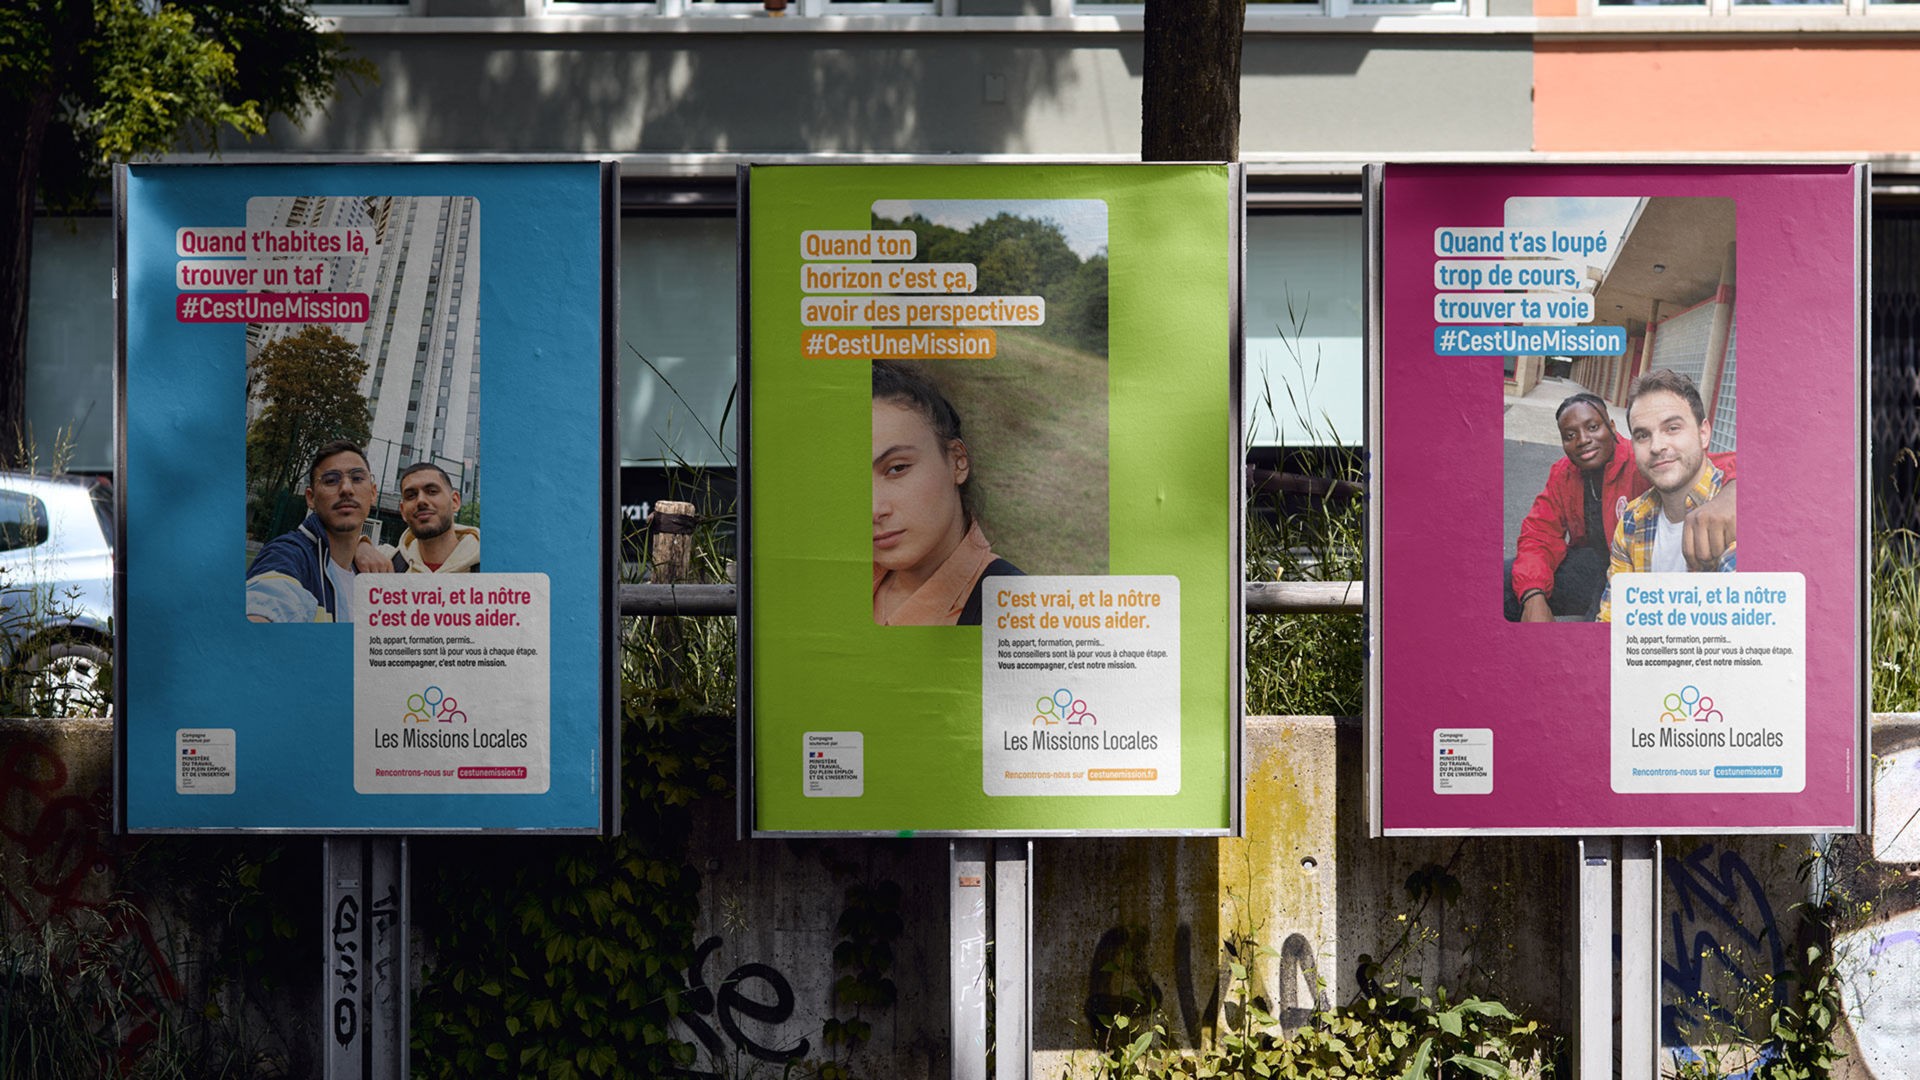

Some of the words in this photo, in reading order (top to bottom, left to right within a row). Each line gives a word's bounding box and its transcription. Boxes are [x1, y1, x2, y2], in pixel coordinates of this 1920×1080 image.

[183, 230, 246, 253] Quand
[251, 230, 341, 252] t'habites
[347, 230, 368, 255] là,
[807, 234, 871, 256] Quand
[877, 236, 911, 255] ton
[1440, 231, 1504, 254] Quand
[1510, 232, 1546, 252] t'as
[1552, 231, 1606, 257] loupé
[182, 266, 258, 285] trouver
[264, 269, 288, 286] un
[294, 263, 324, 285] taf
[806, 267, 882, 288] horizon
[888, 268, 937, 288] c'est
[944, 272, 972, 293] ça,
[1440, 265, 1482, 290] trop
[1488, 264, 1513, 286] de
[1518, 269, 1581, 288] cours,
[182, 296, 362, 318] #CestUneMission
[806, 300, 858, 321] avoir
[864, 300, 900, 321] des
[906, 300, 1040, 326] perspectives
[1440, 298, 1516, 318] trouver
[1520, 299, 1540, 318] ta
[1547, 296, 1588, 318] voie
[807, 332, 990, 354] #CestUneMission
[1440, 329, 1620, 351] #CestUneMission
[369, 588, 408, 604] C'est
[412, 587, 445, 607] vrai,
[450, 589, 466, 604] et
[470, 588, 483, 604] la
[488, 587, 530, 604] nôtre
[997, 590, 1036, 608] C'est
[1040, 590, 1074, 610] vrai,
[1079, 592, 1095, 607] et
[1100, 590, 1112, 606] la
[1118, 590, 1160, 606] nôtre
[1626, 587, 1664, 604] C'est
[1668, 586, 1702, 606] vrai,
[1706, 588, 1722, 604] et
[1727, 587, 1739, 604] la
[1745, 586, 1786, 604] nôtre
[369, 610, 406, 626] c'est
[411, 609, 430, 626] de
[434, 613, 471, 626] vous
[475, 609, 520, 626] aider.
[998, 612, 1036, 630] c'est
[1040, 612, 1059, 629] de
[1063, 616, 1100, 628] vous
[1105, 612, 1149, 628] aider.
[1626, 609, 1663, 626] c'est
[1668, 608, 1686, 626] de
[1690, 612, 1727, 626] vous
[1732, 608, 1776, 625] aider.
[369, 636, 382, 645] Job,
[383, 636, 408, 646] appart,
[408, 636, 444, 645] formation,
[998, 639, 1011, 648] Job,
[1012, 639, 1037, 648] appart,
[1038, 638, 1074, 648] formation,
[1626, 635, 1639, 644] Job,
[1640, 636, 1664, 645] appart,
[1665, 635, 1701, 644] formation,
[369, 647, 383, 656] Nos
[384, 647, 422, 656] conseillers
[422, 648, 438, 656] sont
[440, 647, 446, 656] là
[448, 648, 464, 657] pour
[465, 648, 482, 656] vous
[483, 647, 488, 656] à
[489, 647, 515, 656] chaque
[516, 647, 538, 656] étape.
[998, 650, 1012, 658] Nos
[1012, 649, 1051, 658] conseillers
[1052, 650, 1068, 658] sont
[1069, 650, 1076, 658] là
[1077, 651, 1094, 659] pour
[1113, 650, 1117, 658] à
[1119, 650, 1144, 659] chaque
[1146, 649, 1169, 658] étape.
[1626, 646, 1640, 655] Nos
[1640, 646, 1678, 655] conseillers
[1679, 647, 1695, 655] sont
[1696, 646, 1703, 655] là
[1704, 648, 1720, 656] pour
[1739, 646, 1744, 655] à
[1745, 646, 1771, 656] chaque
[1772, 646, 1793, 656] étape.
[369, 659, 386, 667] Vous
[387, 660, 438, 668] accompagner,
[438, 659, 456, 667] c'est
[457, 659, 476, 667] notre
[478, 658, 506, 667] mission.
[997, 661, 1016, 670] Vous
[1016, 662, 1067, 671] accompagner,
[1068, 661, 1085, 669] c'est
[1107, 661, 1136, 669] mission.
[1626, 658, 1643, 666] Vous
[1644, 660, 1694, 668] accompagner,
[1695, 658, 1712, 666] c'est
[1713, 658, 1732, 666] notre
[1734, 658, 1762, 666] mission.
[375, 728, 398, 748] Les
[403, 728, 469, 748] Missions
[474, 728, 527, 748] Locales
[1004, 730, 1028, 750] Les
[1032, 730, 1099, 750] Missions
[1104, 730, 1157, 750] Locales
[1632, 728, 1655, 748] Les
[1660, 728, 1725, 747] Missions
[1730, 728, 1783, 747] Locales
[376, 768, 441, 777] Rencontrons-nous
[460, 768, 524, 776] cestunemission.fr
[1004, 770, 1071, 779] Rencontrons-nous
[1072, 771, 1085, 779] sur
[1089, 770, 1155, 779] cestunemission.fr
[1632, 768, 1698, 776] Rencontrons-nous
[1715, 767, 1780, 777] cestunemission.fr
